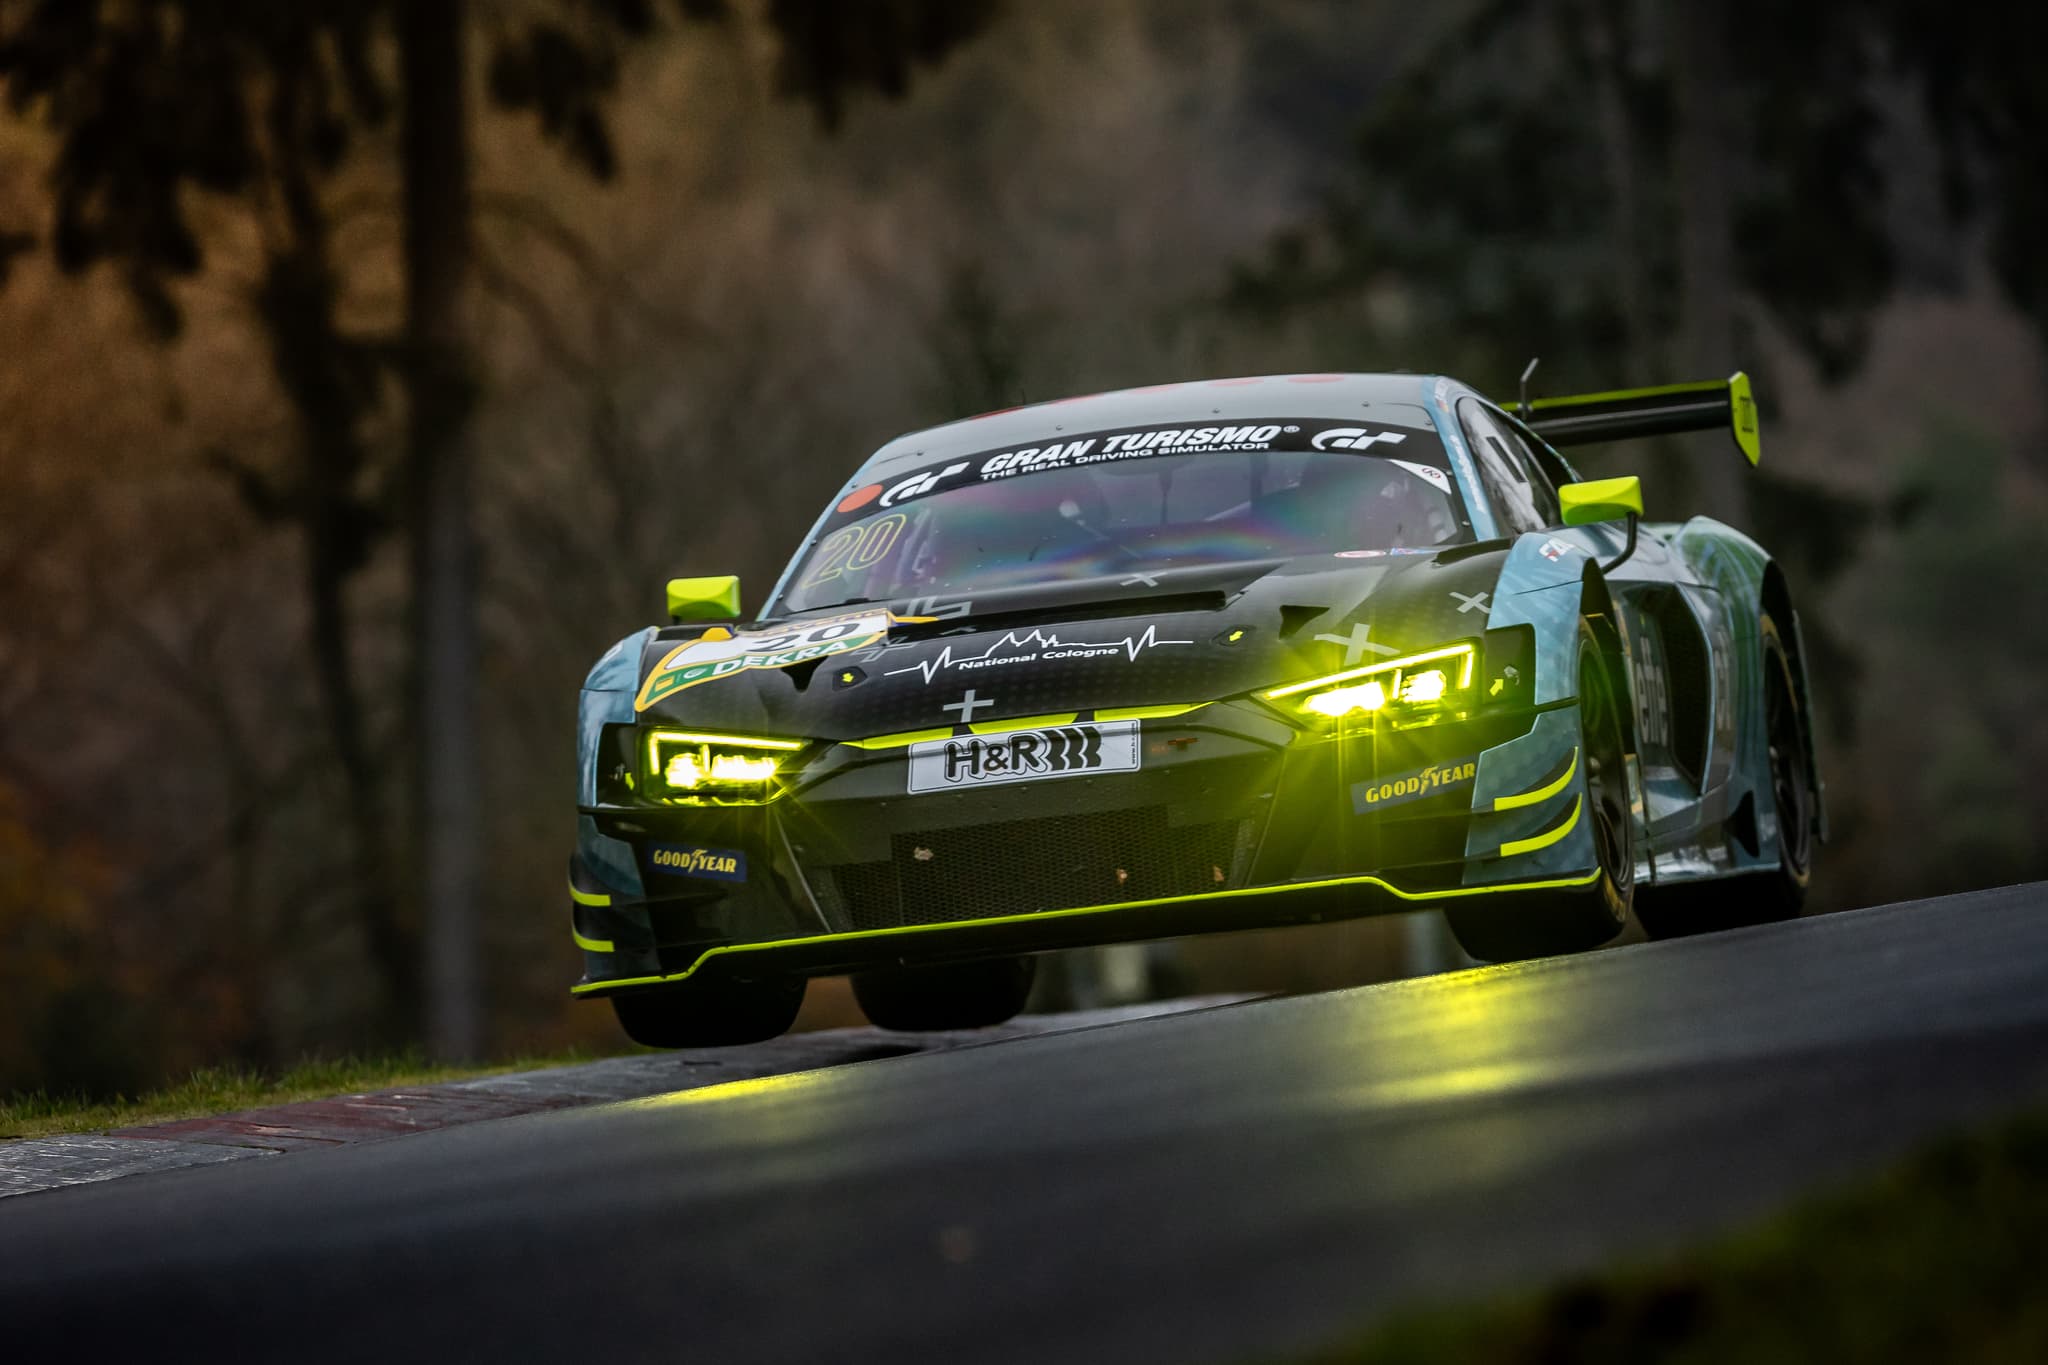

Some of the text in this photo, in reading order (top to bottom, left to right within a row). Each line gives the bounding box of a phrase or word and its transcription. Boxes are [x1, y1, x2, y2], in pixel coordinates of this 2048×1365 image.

[980, 442, 1270, 480] THE REAL DRIVING SIMULATOR
[981, 439, 1096, 473] GRAN
[802, 514, 906, 588] 20
[746, 623, 860, 652] 20
[711, 641, 849, 676] DEKRA
[958, 647, 1120, 671] National Cologne
[944, 733, 1049, 783] H&R
[1365, 762, 1476, 804] GOODYEAR
[653, 849, 737, 874] GOODYEAR
